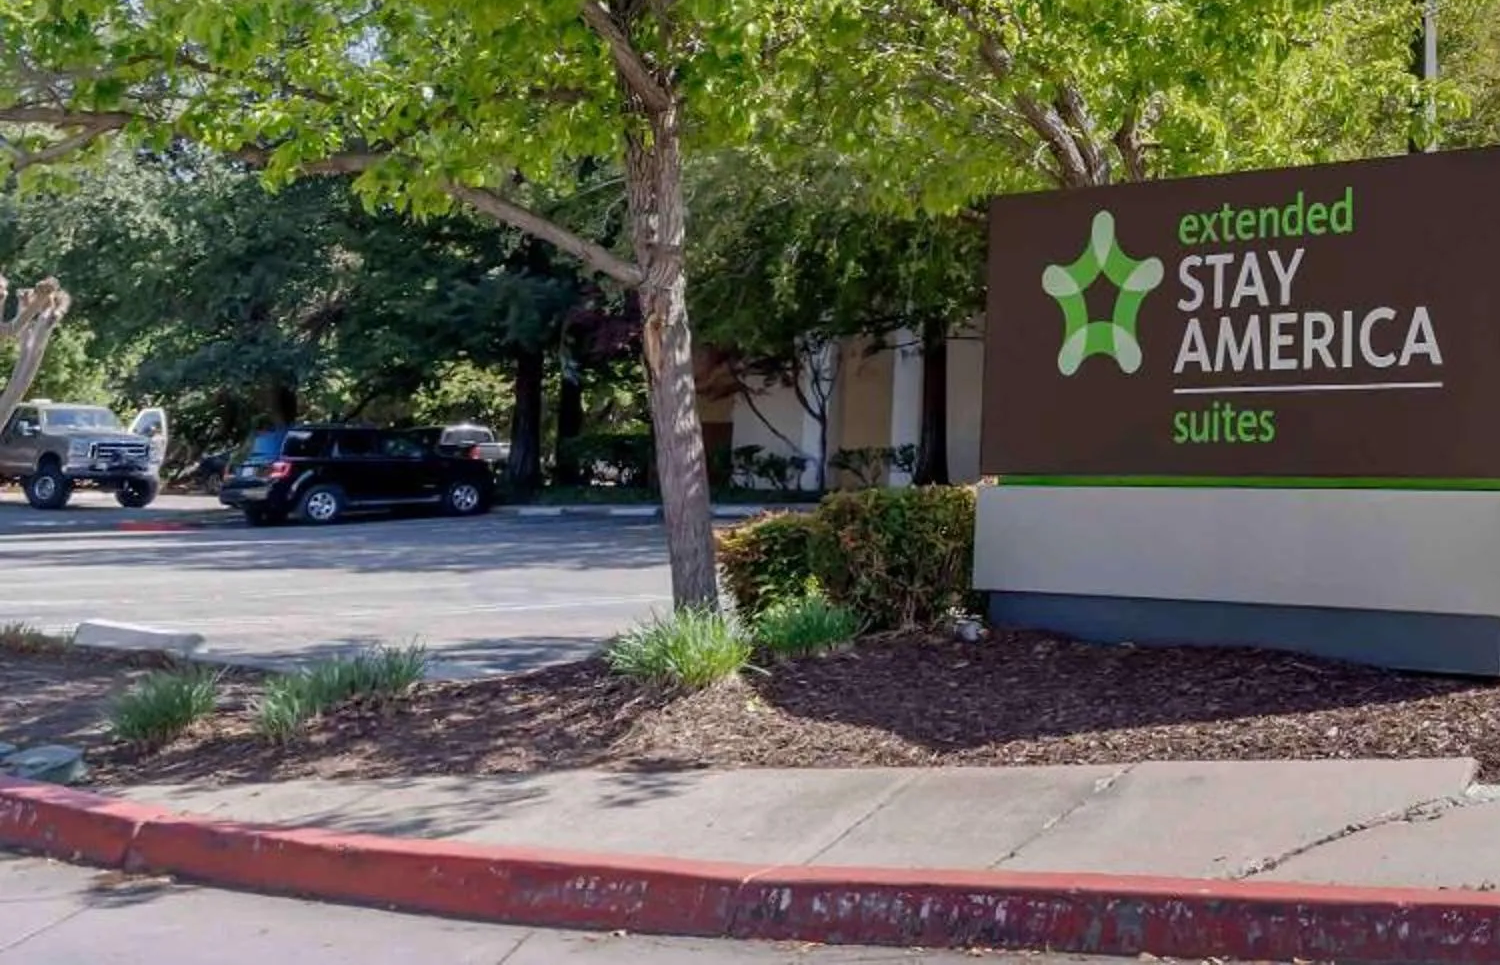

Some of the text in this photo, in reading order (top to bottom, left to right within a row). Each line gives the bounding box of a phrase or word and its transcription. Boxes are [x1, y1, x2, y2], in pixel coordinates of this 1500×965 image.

[1179, 187, 1353, 244] extended
[1178, 249, 1304, 311] STAY
[1174, 307, 1443, 373] AMERICA
[1174, 402, 1275, 443] suites
